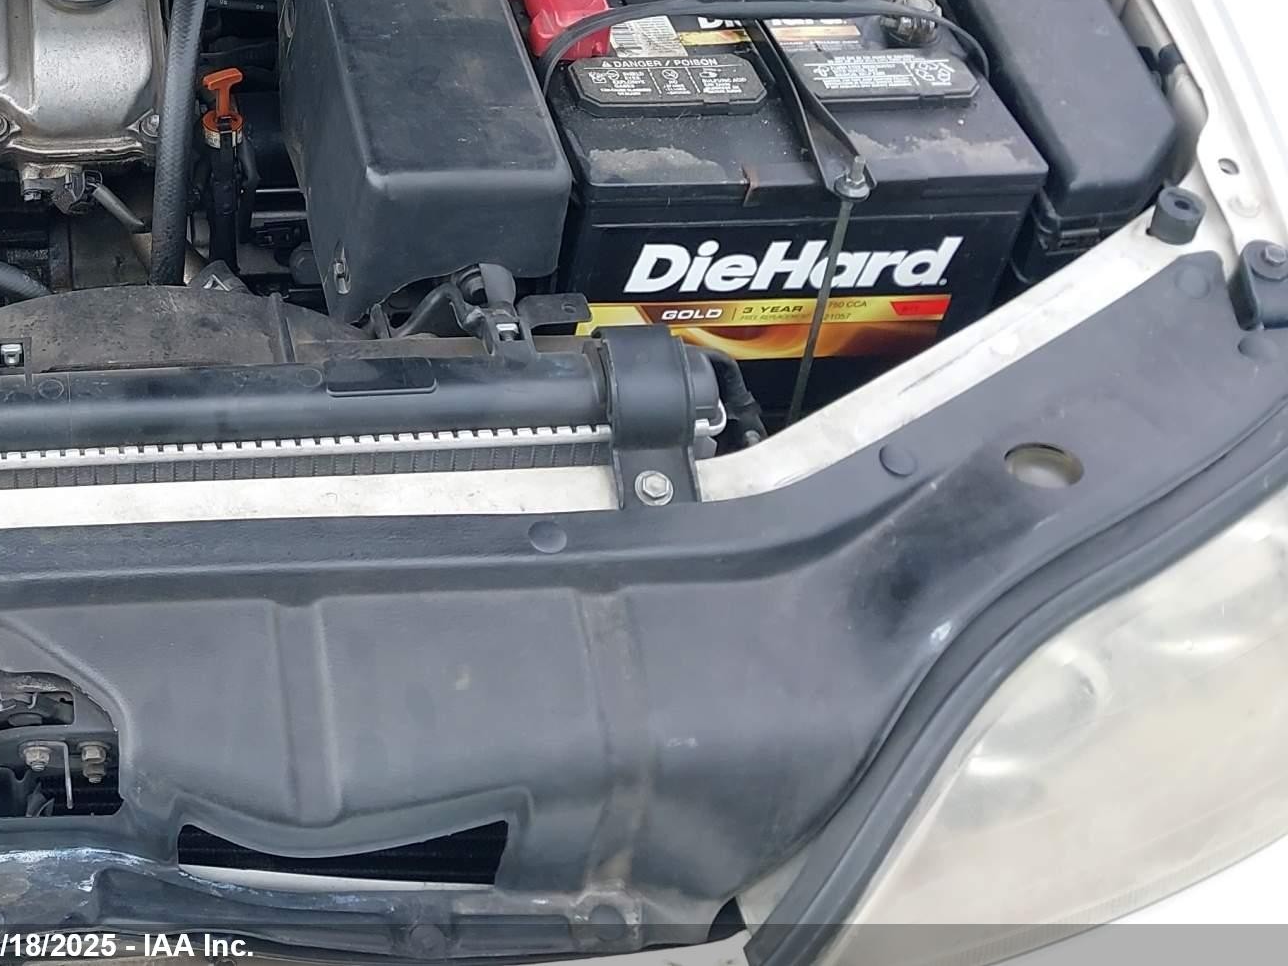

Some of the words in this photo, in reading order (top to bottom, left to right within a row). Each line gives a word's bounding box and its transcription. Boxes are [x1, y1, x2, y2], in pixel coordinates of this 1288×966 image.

[612, 59, 662, 68] DANGER
[673, 57, 719, 67] POISON
[623, 235, 964, 294] DieHard
[846, 300, 868, 309] CCA
[661, 308, 723, 321] GOLD
[742, 306, 753, 314] 3
[760, 305, 804, 314] YEAR
